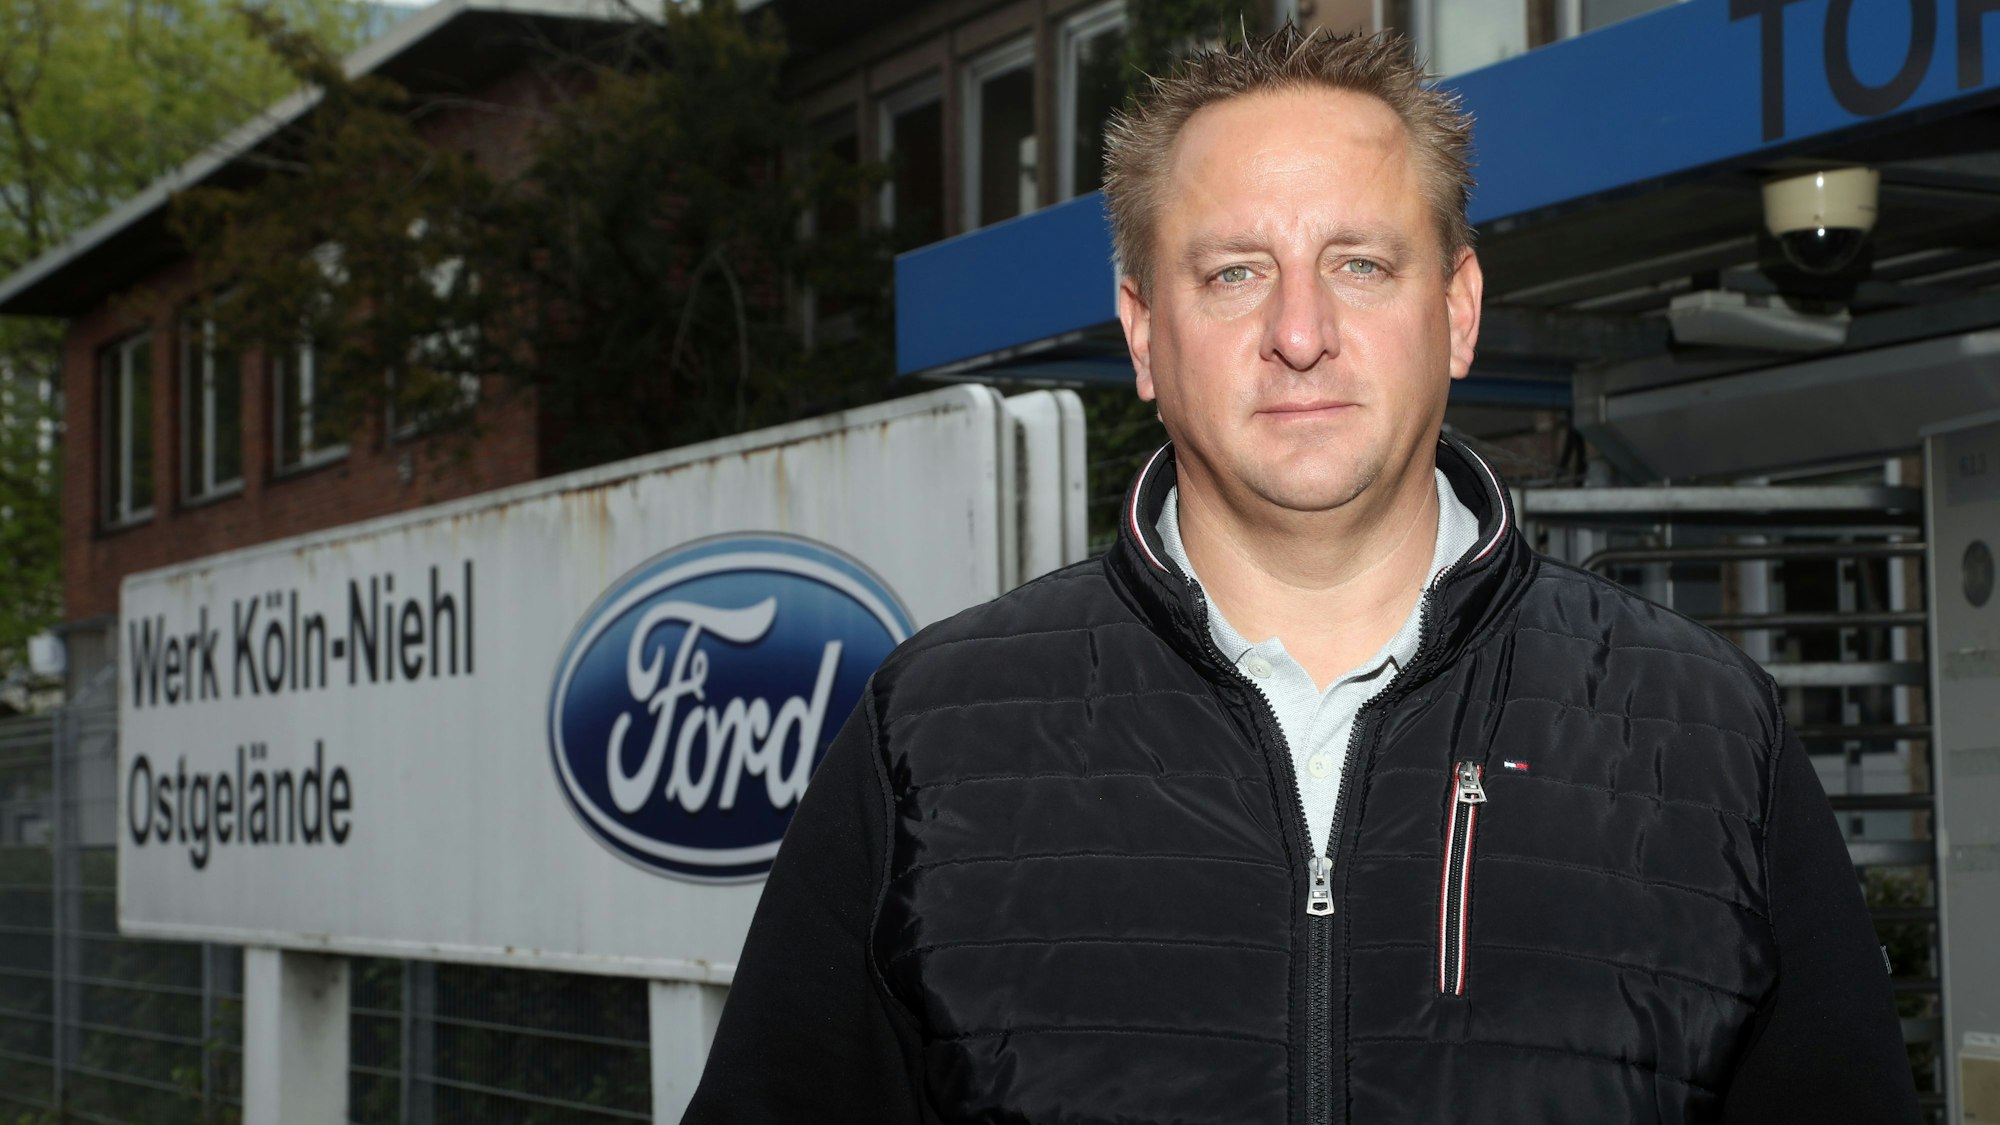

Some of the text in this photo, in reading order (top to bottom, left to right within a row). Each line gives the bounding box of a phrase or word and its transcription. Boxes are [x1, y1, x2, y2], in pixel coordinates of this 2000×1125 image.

[129, 559, 475, 709] Werk Köln-Niehl
[606, 596, 842, 814] Ford
[128, 740, 353, 872] Ostgelände
